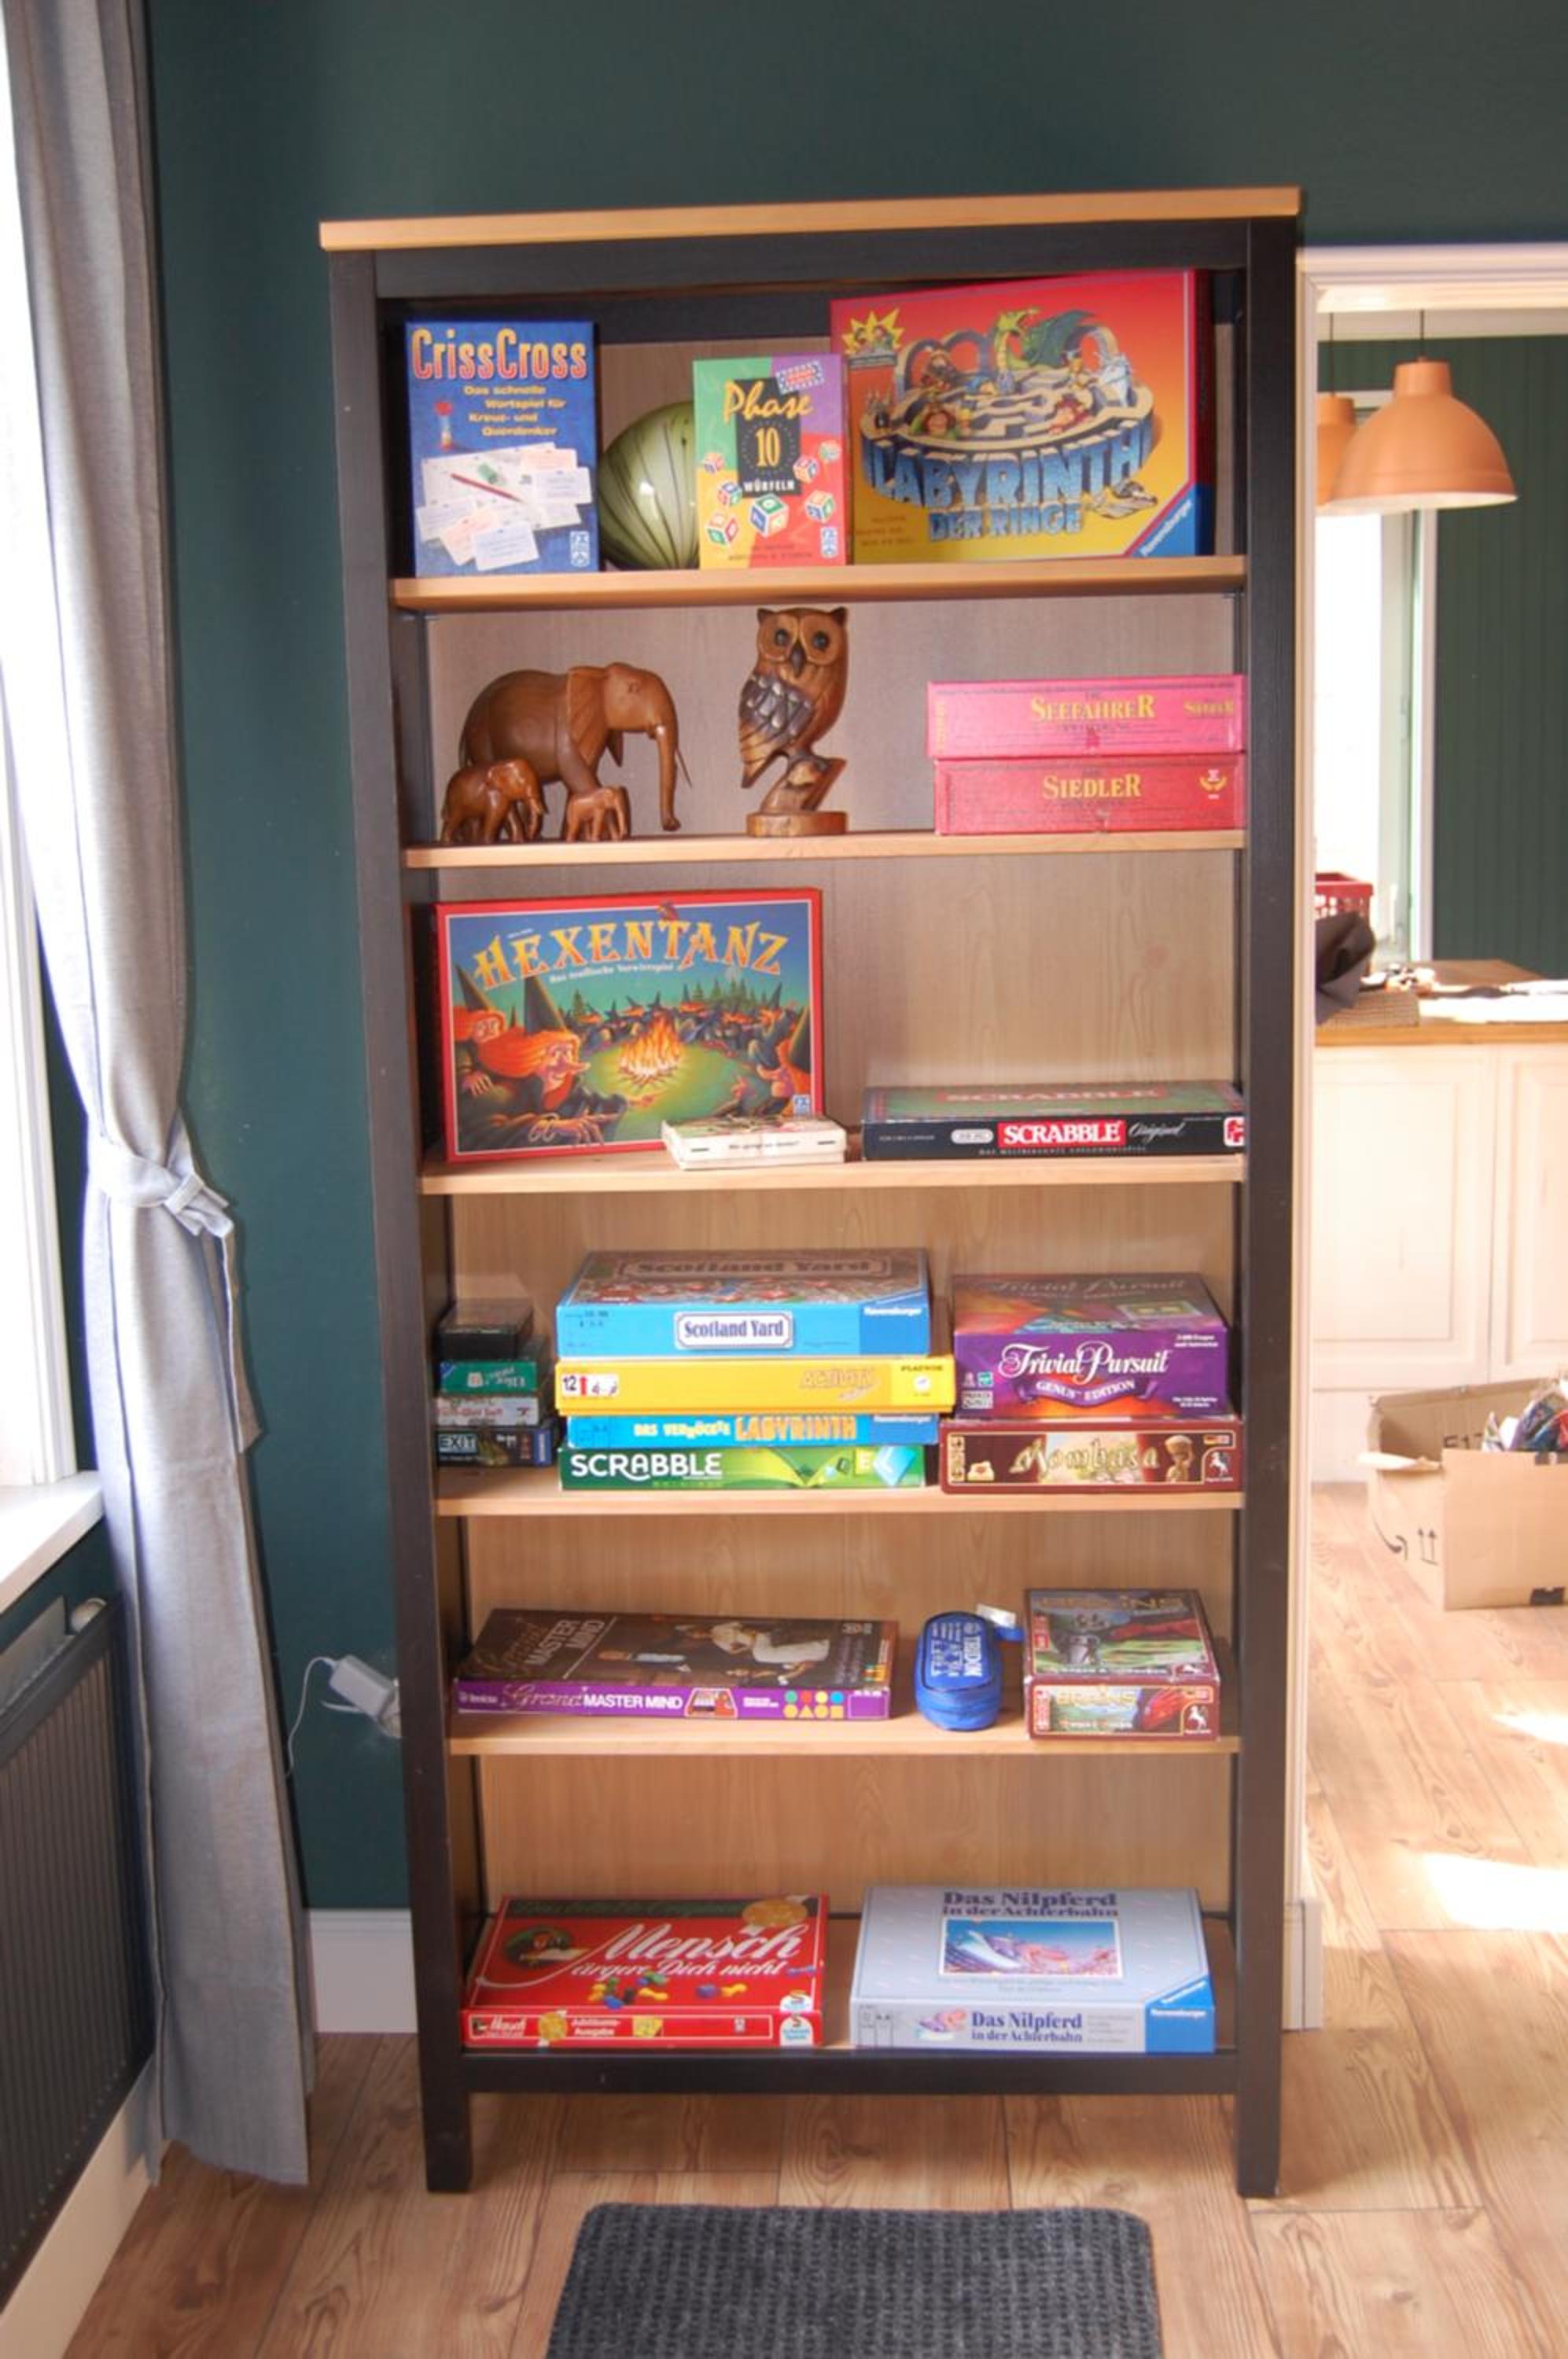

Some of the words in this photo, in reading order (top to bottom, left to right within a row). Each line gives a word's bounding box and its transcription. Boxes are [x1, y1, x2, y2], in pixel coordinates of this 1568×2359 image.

[410, 327, 588, 380] CrissCross
[723, 379, 815, 424] Phase
[755, 427, 781, 467] 10
[872, 420, 1143, 507] LABYRINTH
[929, 505, 982, 542] DER
[988, 501, 1084, 536] RINGE
[1043, 773, 1142, 800] SIEDLER
[473, 920, 789, 991] HEXENTANZ
[1003, 1122, 1121, 1144] SCRABBLE
[683, 1319, 748, 1338] Scotland
[750, 1318, 784, 1338] Yard
[998, 1342, 1088, 1378] Trivial
[1071, 1340, 1171, 1386] Pursuit
[1084, 1378, 1136, 1401] EDITION
[734, 1415, 857, 1441] LABYRINTH
[438, 1433, 478, 1452] EXIT
[570, 1452, 723, 1481] SCRABBLE
[583, 1693, 642, 1709] MASTER
[644, 1695, 683, 1710] MIND
[944, 1890, 995, 1905] Das
[1001, 1890, 1118, 1909] Nilpferd
[602, 1923, 810, 1962] Mensch
[658, 1960, 718, 1976] Dich
[720, 1961, 789, 1977] nicht
[971, 2011, 1005, 2028] Das
[1007, 2011, 1083, 2032] Nilpferd
[971, 2030, 985, 2041] in
[986, 2030, 1009, 2042] der
